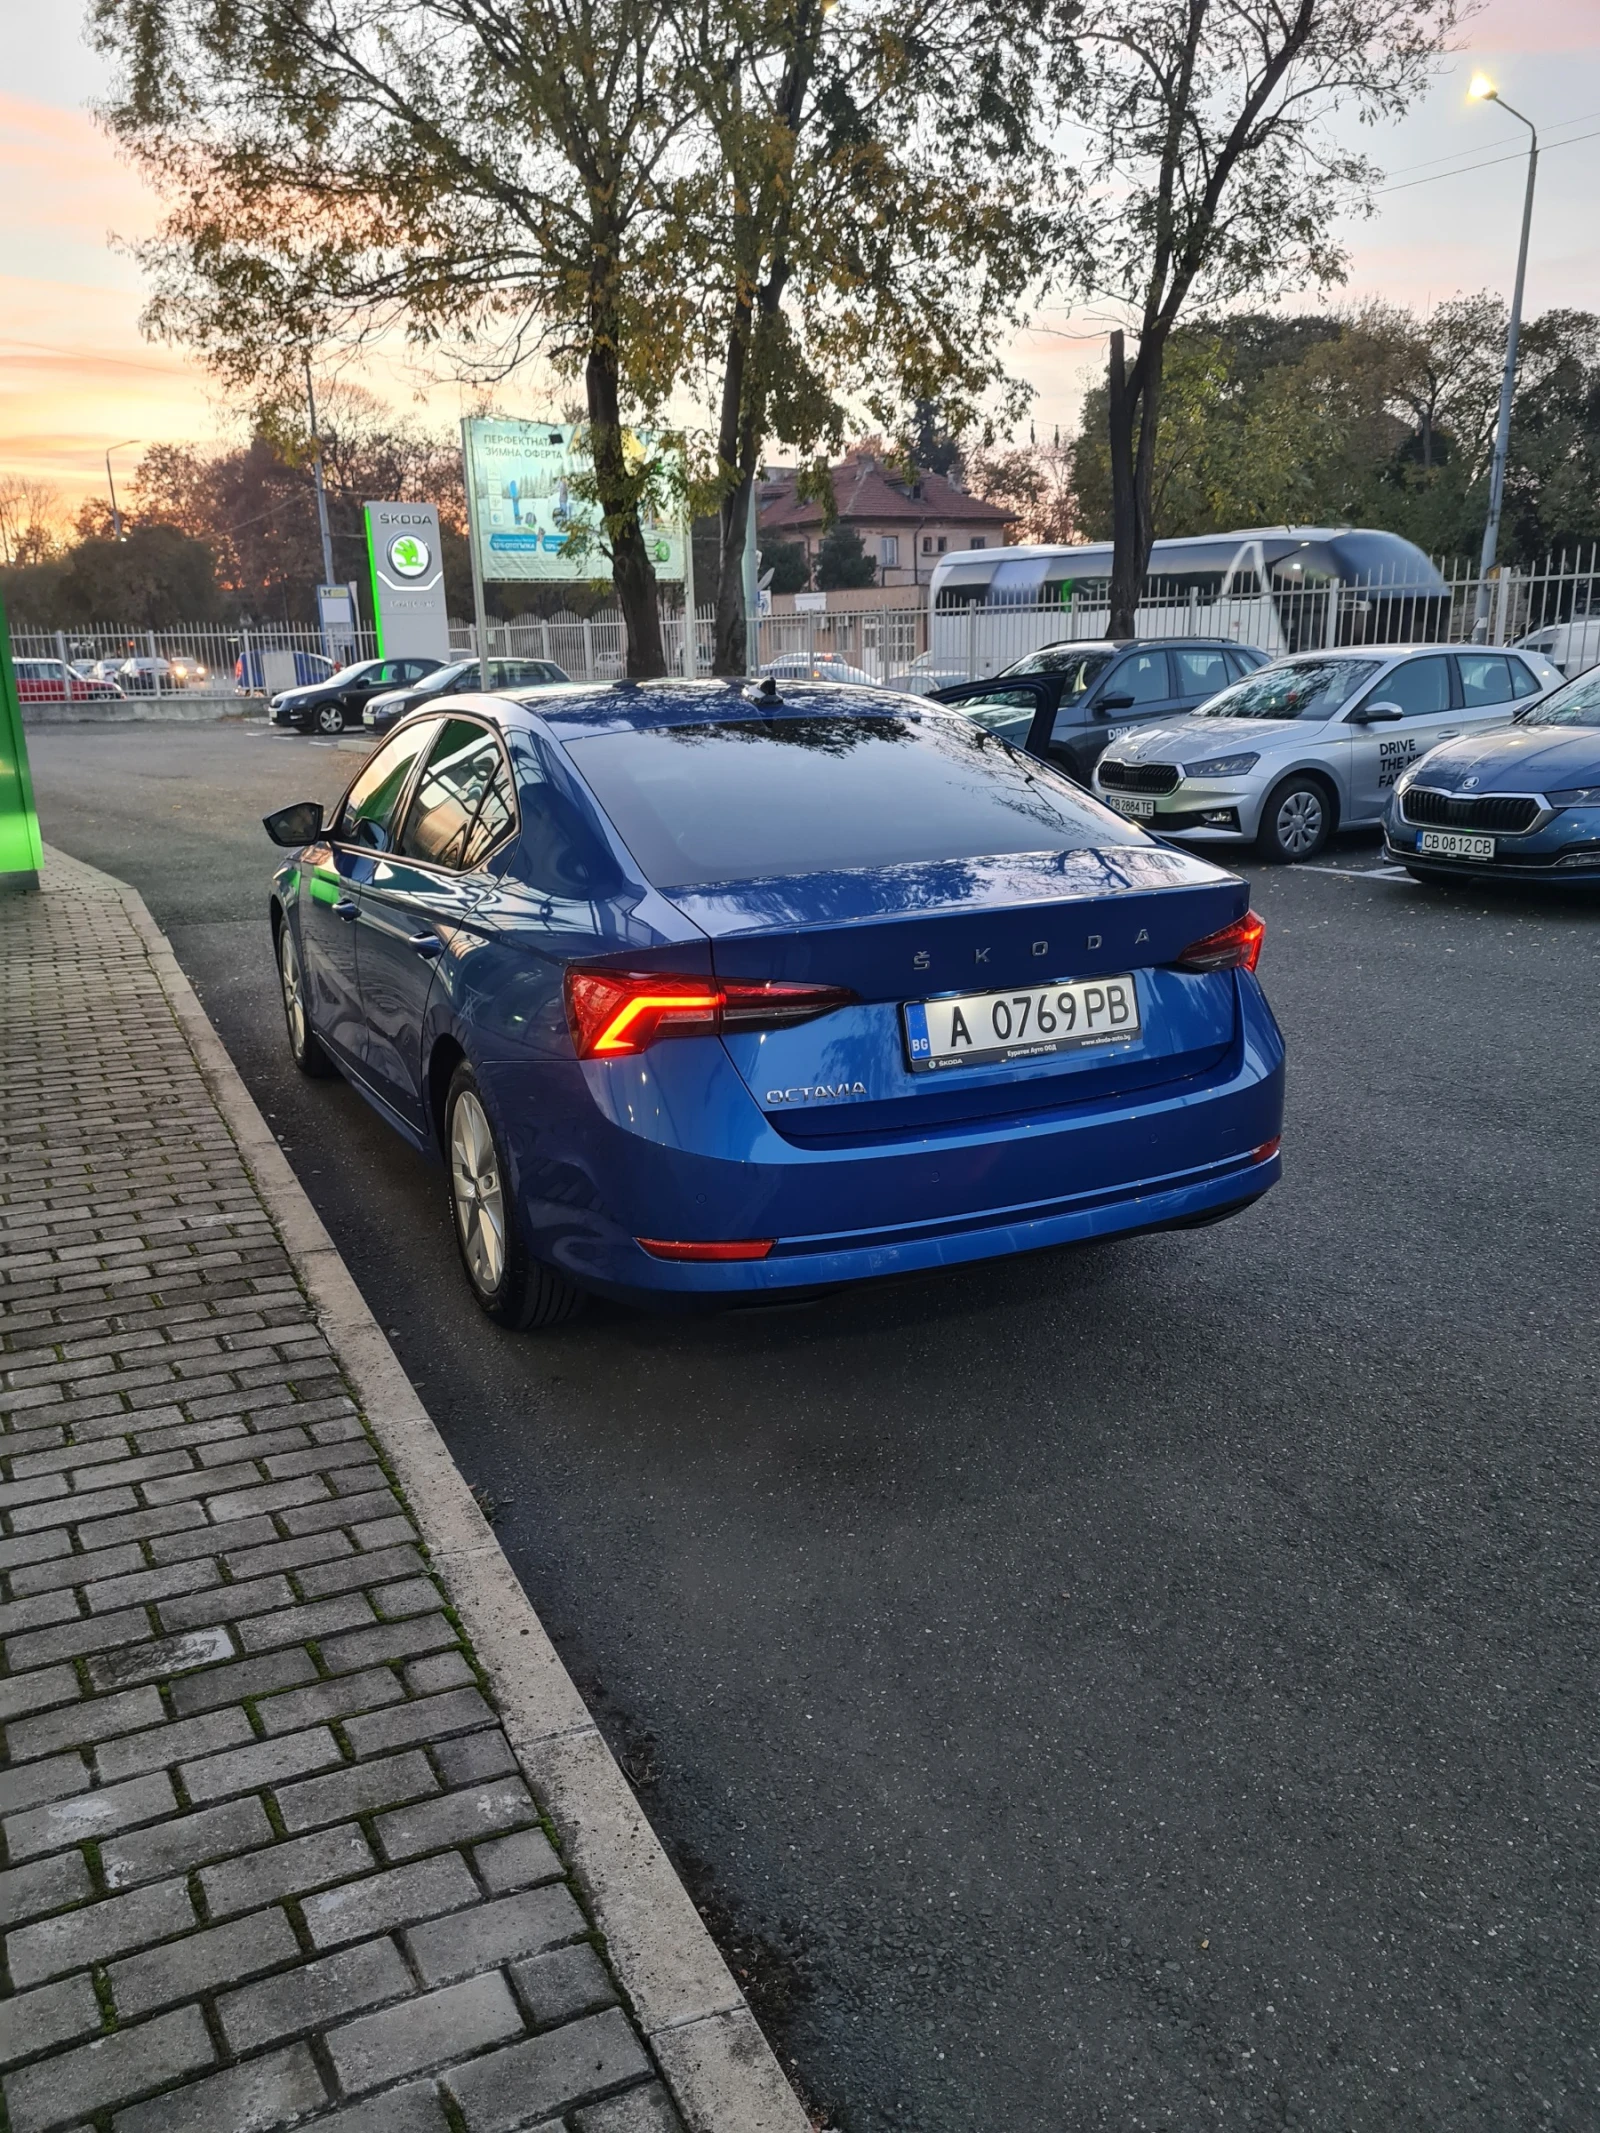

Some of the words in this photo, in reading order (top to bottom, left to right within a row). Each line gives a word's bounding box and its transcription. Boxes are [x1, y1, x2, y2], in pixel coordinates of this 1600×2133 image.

[485, 447, 522, 457] ЗИМНА
[525, 448, 563, 460] ОФЕРТА
[380, 513, 432, 526] ŠKODA
[1379, 738, 1416, 756] DRIVE
[1380, 756, 1404, 772] THE
[1121, 800, 1140, 814] 2884
[1141, 802, 1152, 815] TE
[1424, 834, 1440, 849] CB
[1442, 836, 1472, 853] 0812
[1474, 839, 1492, 854] CB
[913, 928, 1150, 970] ŠKODA
[950, 1006, 972, 1047] A
[912, 1037, 929, 1052] BG
[766, 1082, 867, 1104] OCTAVIA
